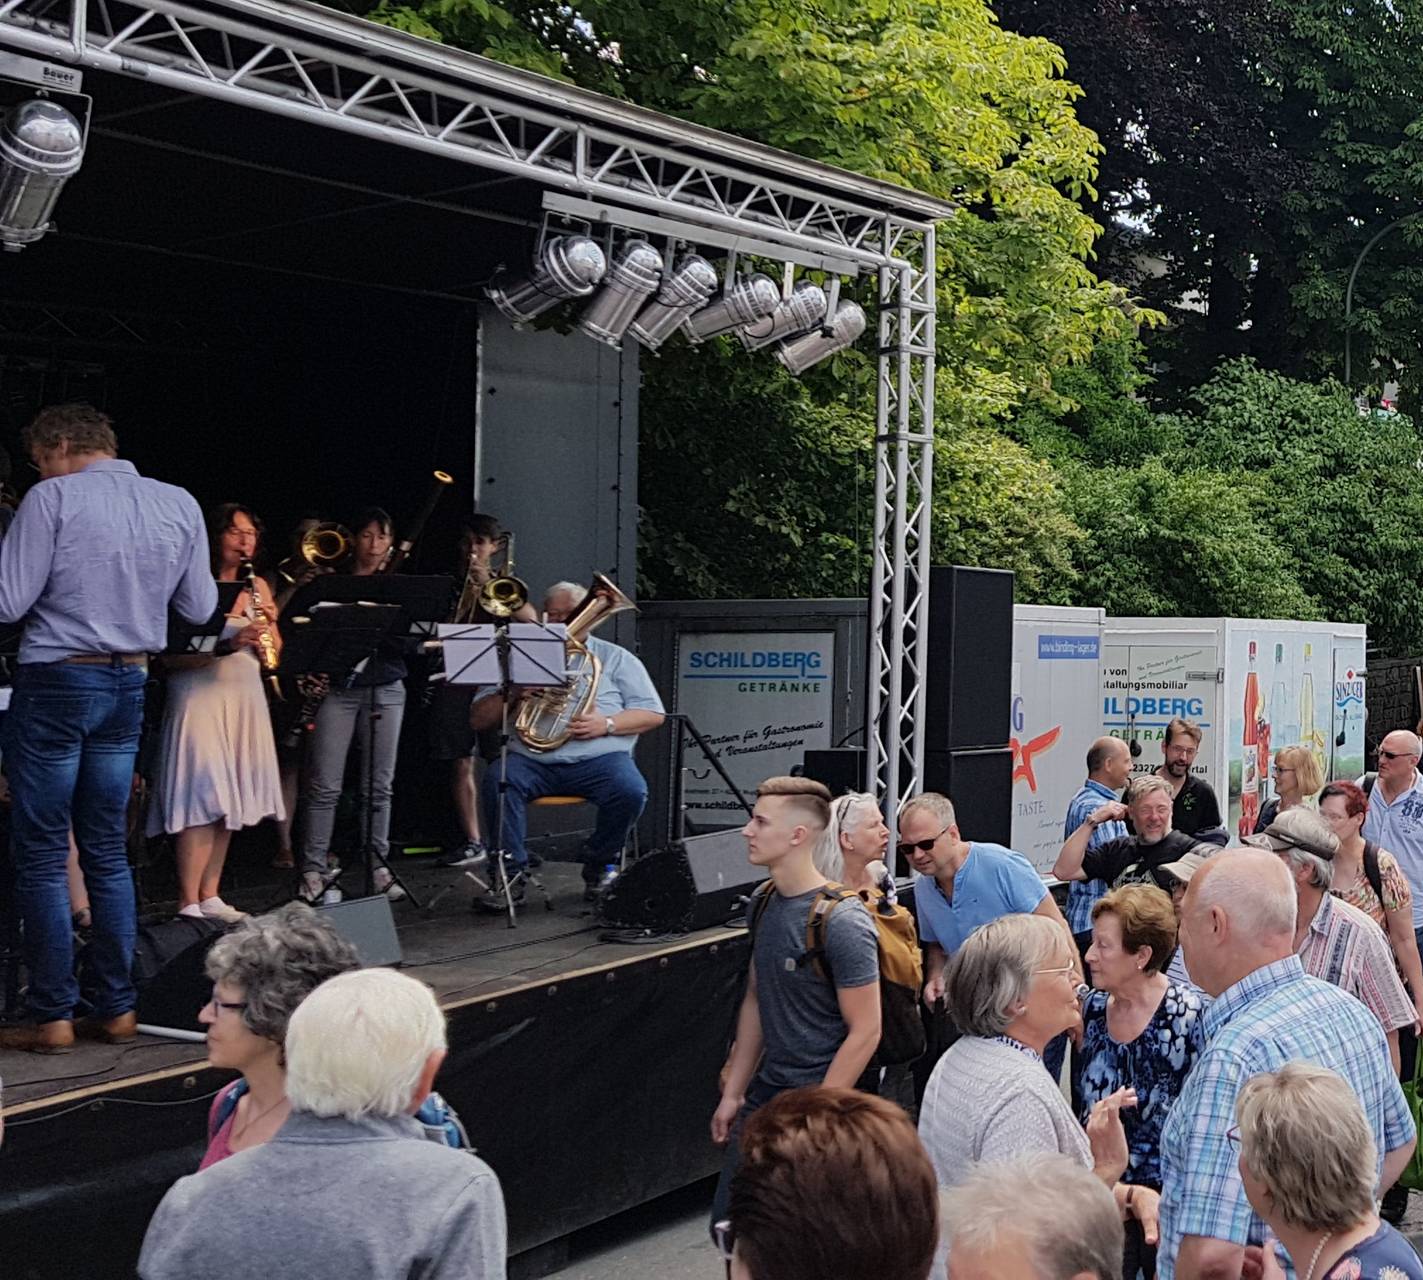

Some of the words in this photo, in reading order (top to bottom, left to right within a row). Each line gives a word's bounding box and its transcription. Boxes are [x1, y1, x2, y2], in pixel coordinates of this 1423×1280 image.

[689, 651, 822, 677] SCHILDBERG
[1109, 668, 1127, 676] von
[738, 682, 821, 693] GETRÄNKE
[1104, 697, 1204, 719] ILDBERG
[743, 729, 759, 743] für
[763, 720, 824, 738] Gastronomie
[1109, 728, 1166, 740] GETRÄ
[727, 739, 804, 756] Veranstaltungen
